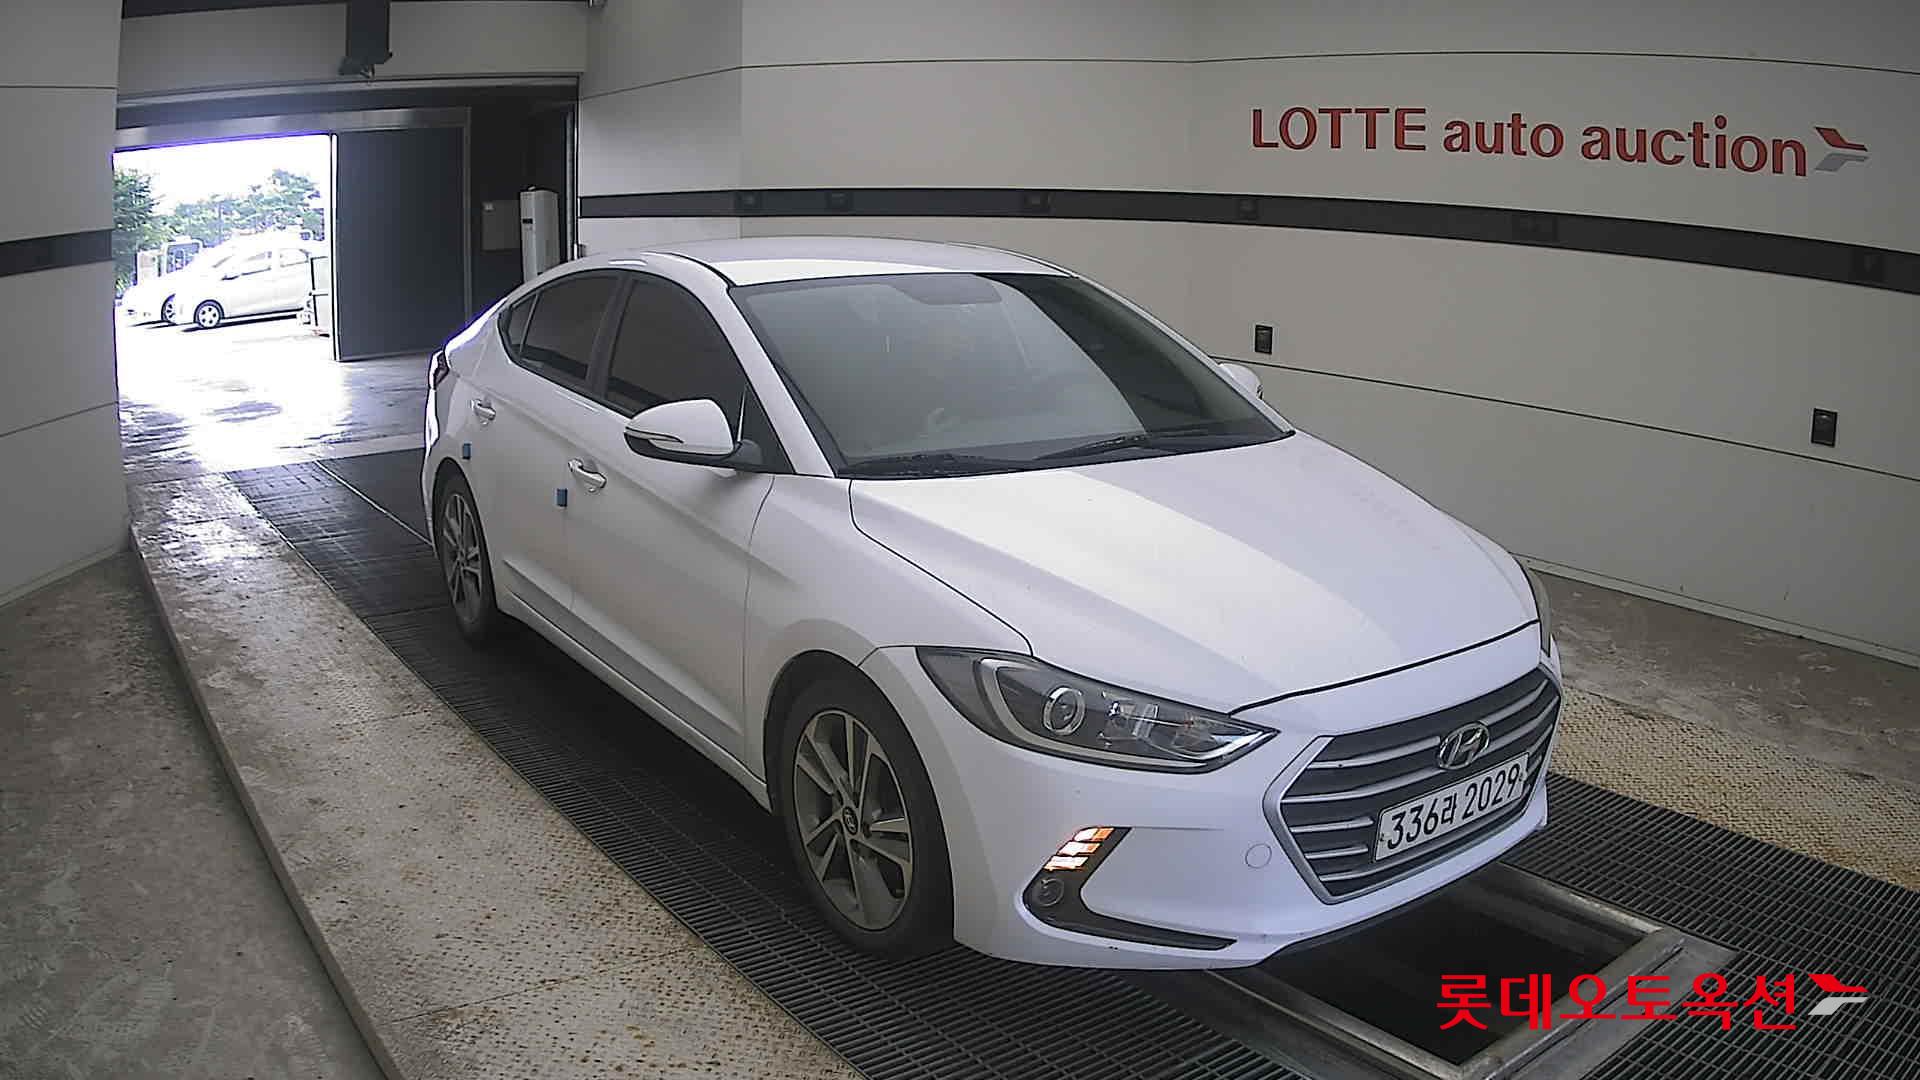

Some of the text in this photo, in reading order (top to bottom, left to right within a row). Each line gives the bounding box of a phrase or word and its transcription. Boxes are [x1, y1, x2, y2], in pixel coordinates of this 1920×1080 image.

[1251, 106, 1809, 178] LOTTE auto auction
[1386, 762, 1521, 850] 336라 2029
